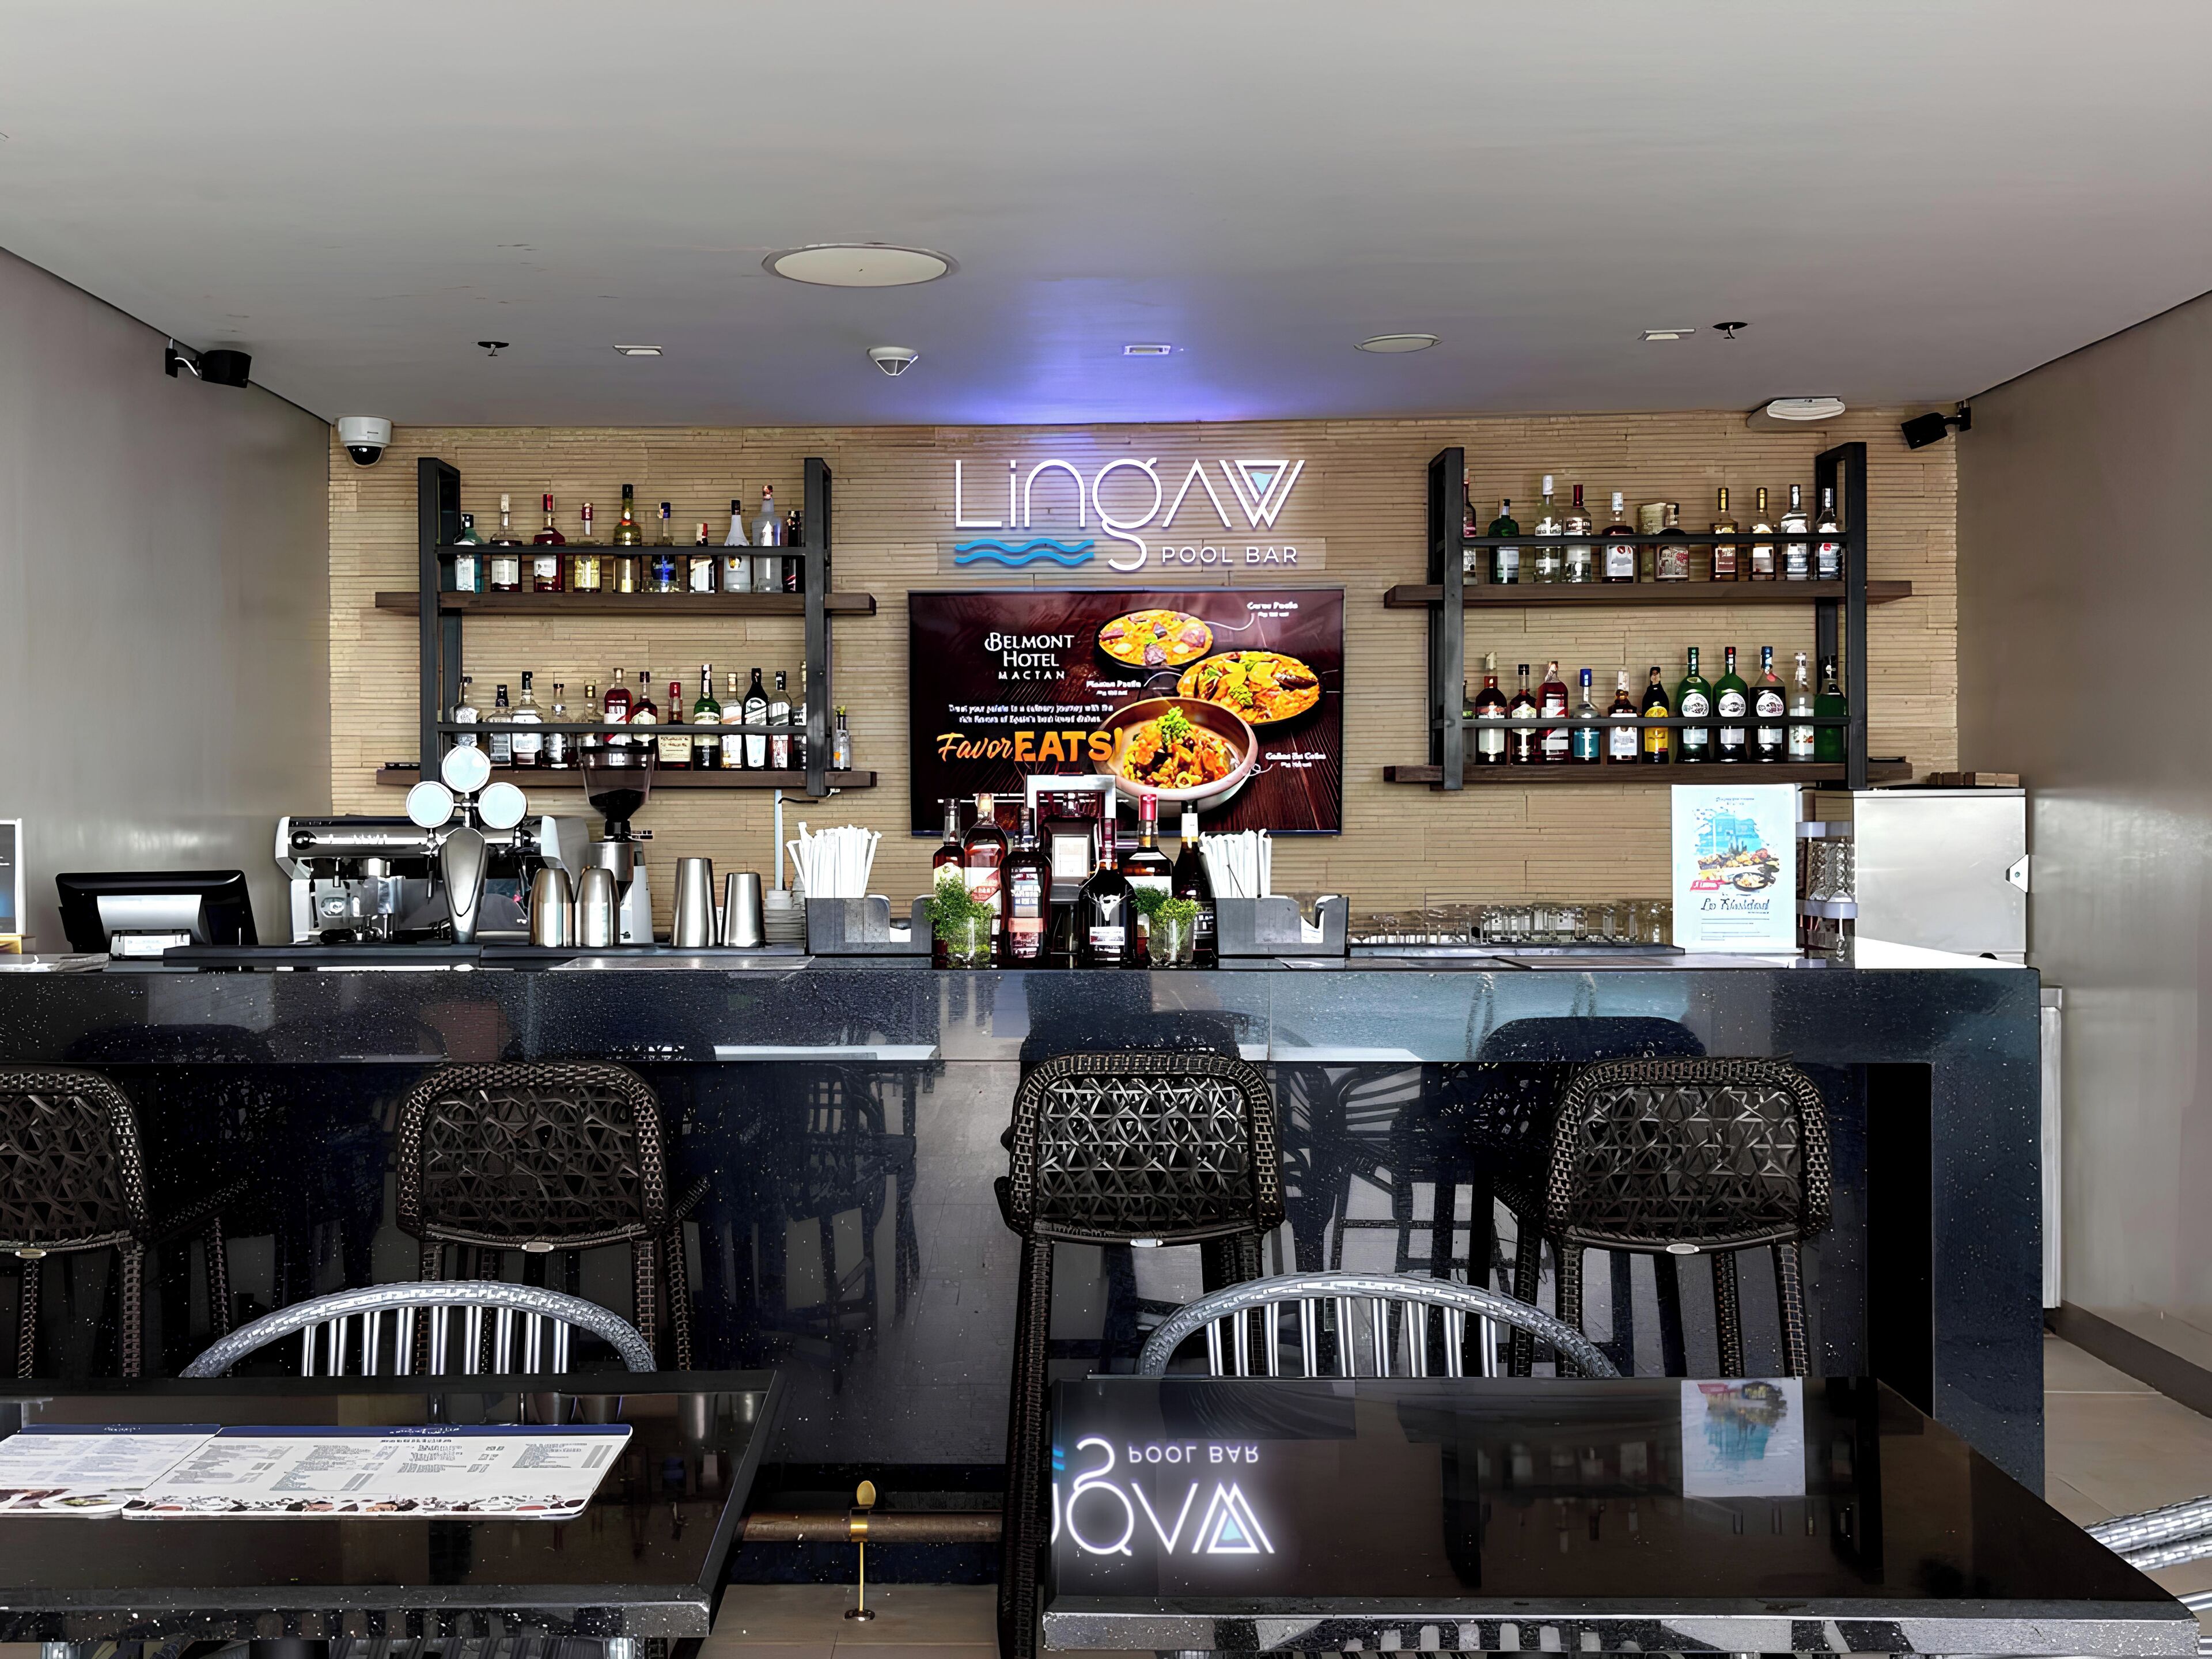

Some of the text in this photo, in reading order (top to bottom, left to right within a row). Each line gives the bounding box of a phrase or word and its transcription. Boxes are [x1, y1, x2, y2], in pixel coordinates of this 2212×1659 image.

[1161, 546, 1297, 563] POOL BAR
[984, 632, 1075, 652] BELMONT
[1003, 651, 1059, 667] HOTEL
[998, 671, 1065, 680] MACTAN
